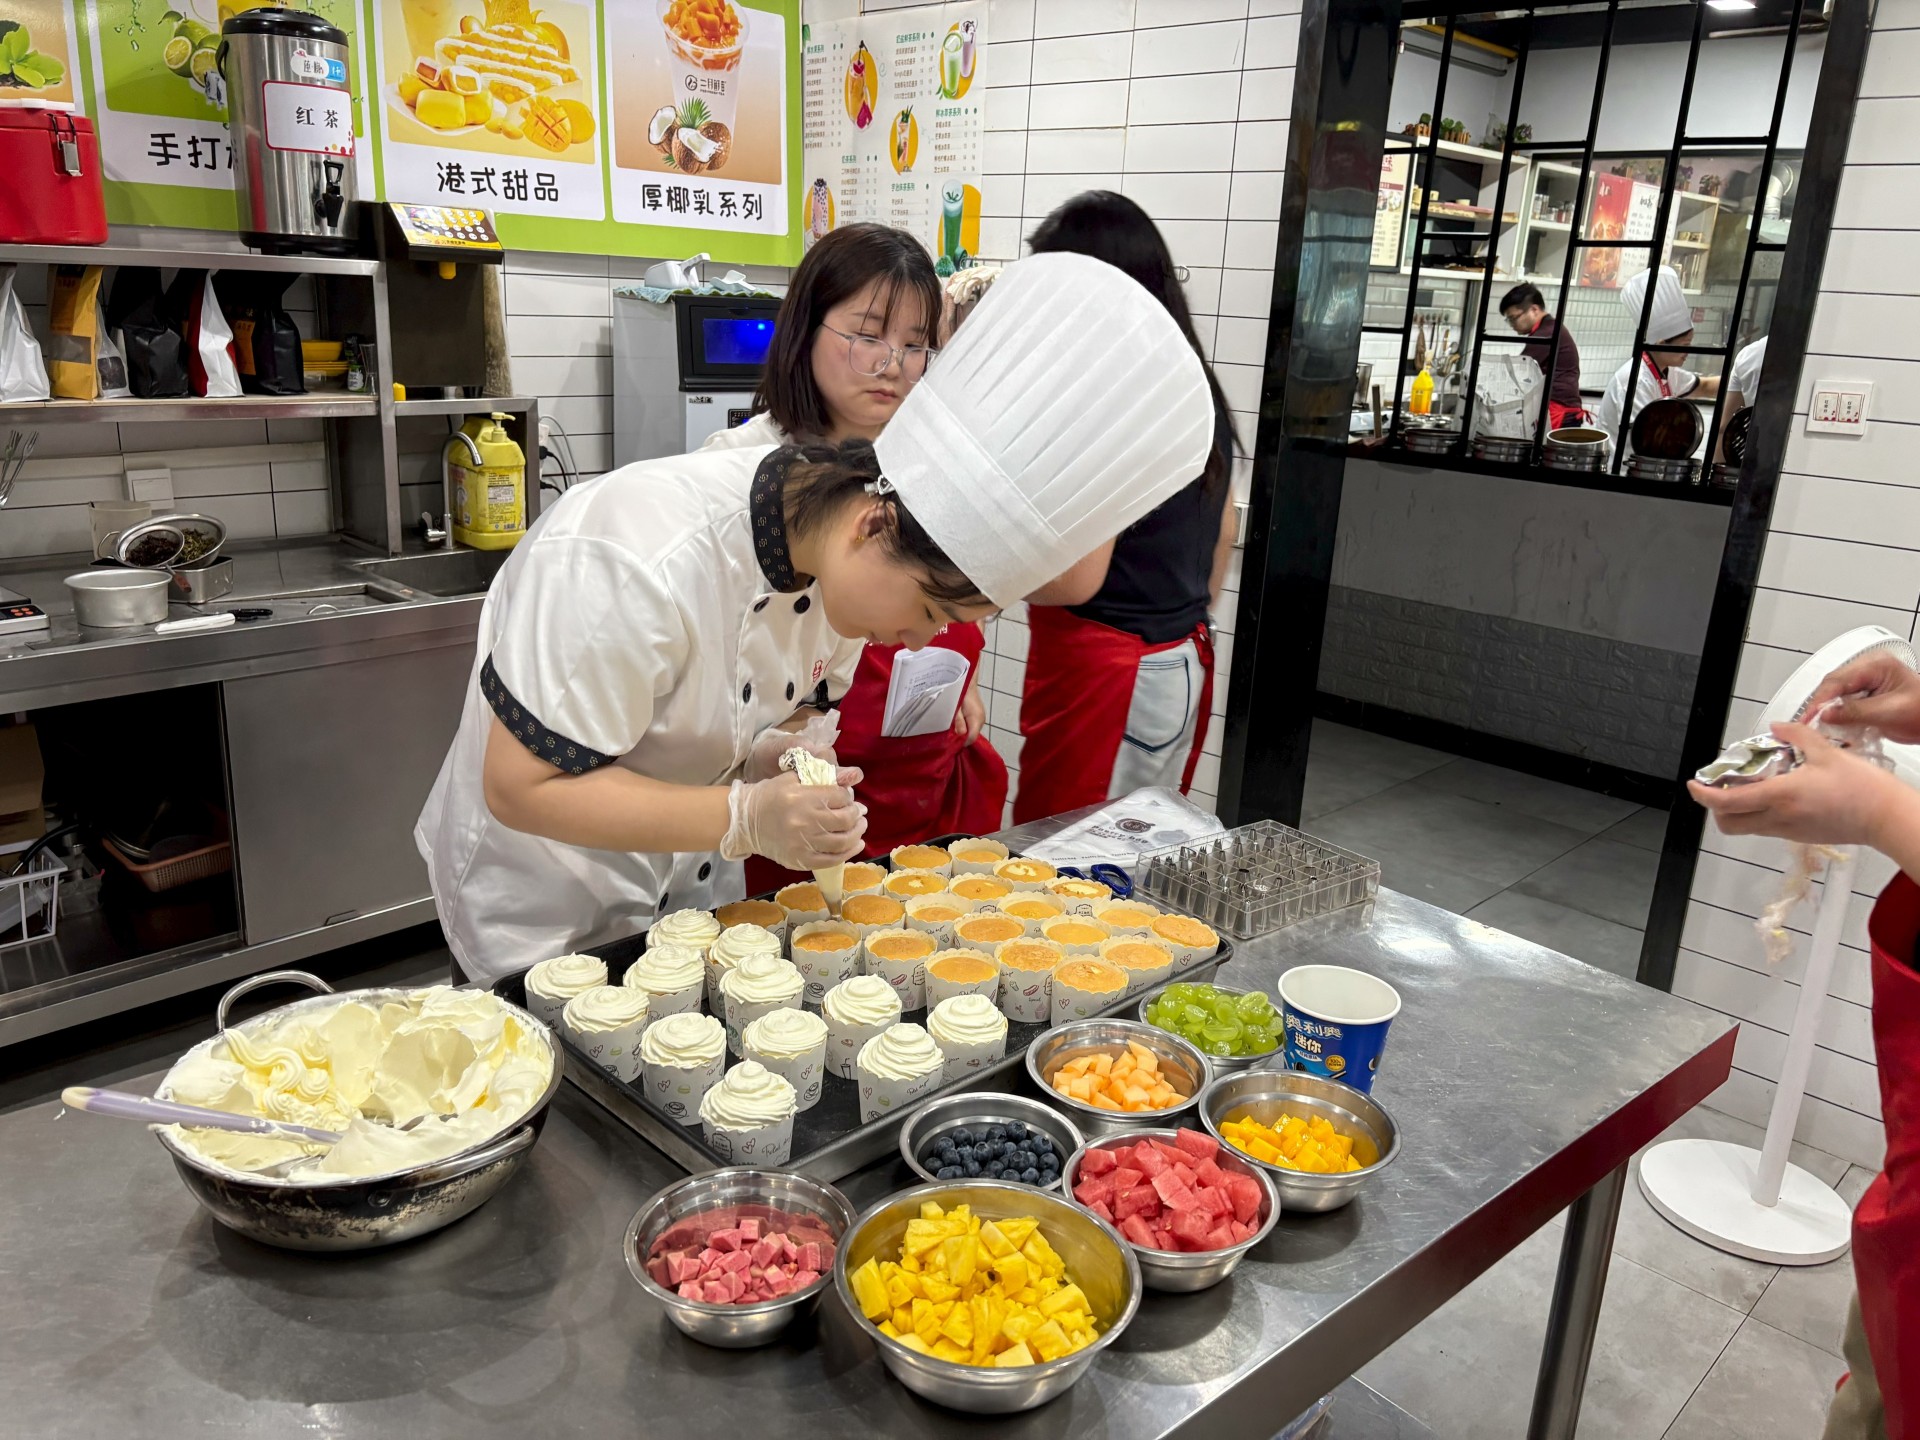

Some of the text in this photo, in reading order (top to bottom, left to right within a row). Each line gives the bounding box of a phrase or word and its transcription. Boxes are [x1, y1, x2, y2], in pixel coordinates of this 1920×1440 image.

[296, 106, 339, 128] 红茶
[148, 133, 232, 170] 手打
[436, 161, 559, 203] 港式甜品
[641, 183, 763, 221] 厚椰乳系列
[1286, 1014, 1342, 1038] 奥利奥
[1295, 1032, 1322, 1053] 迷你
